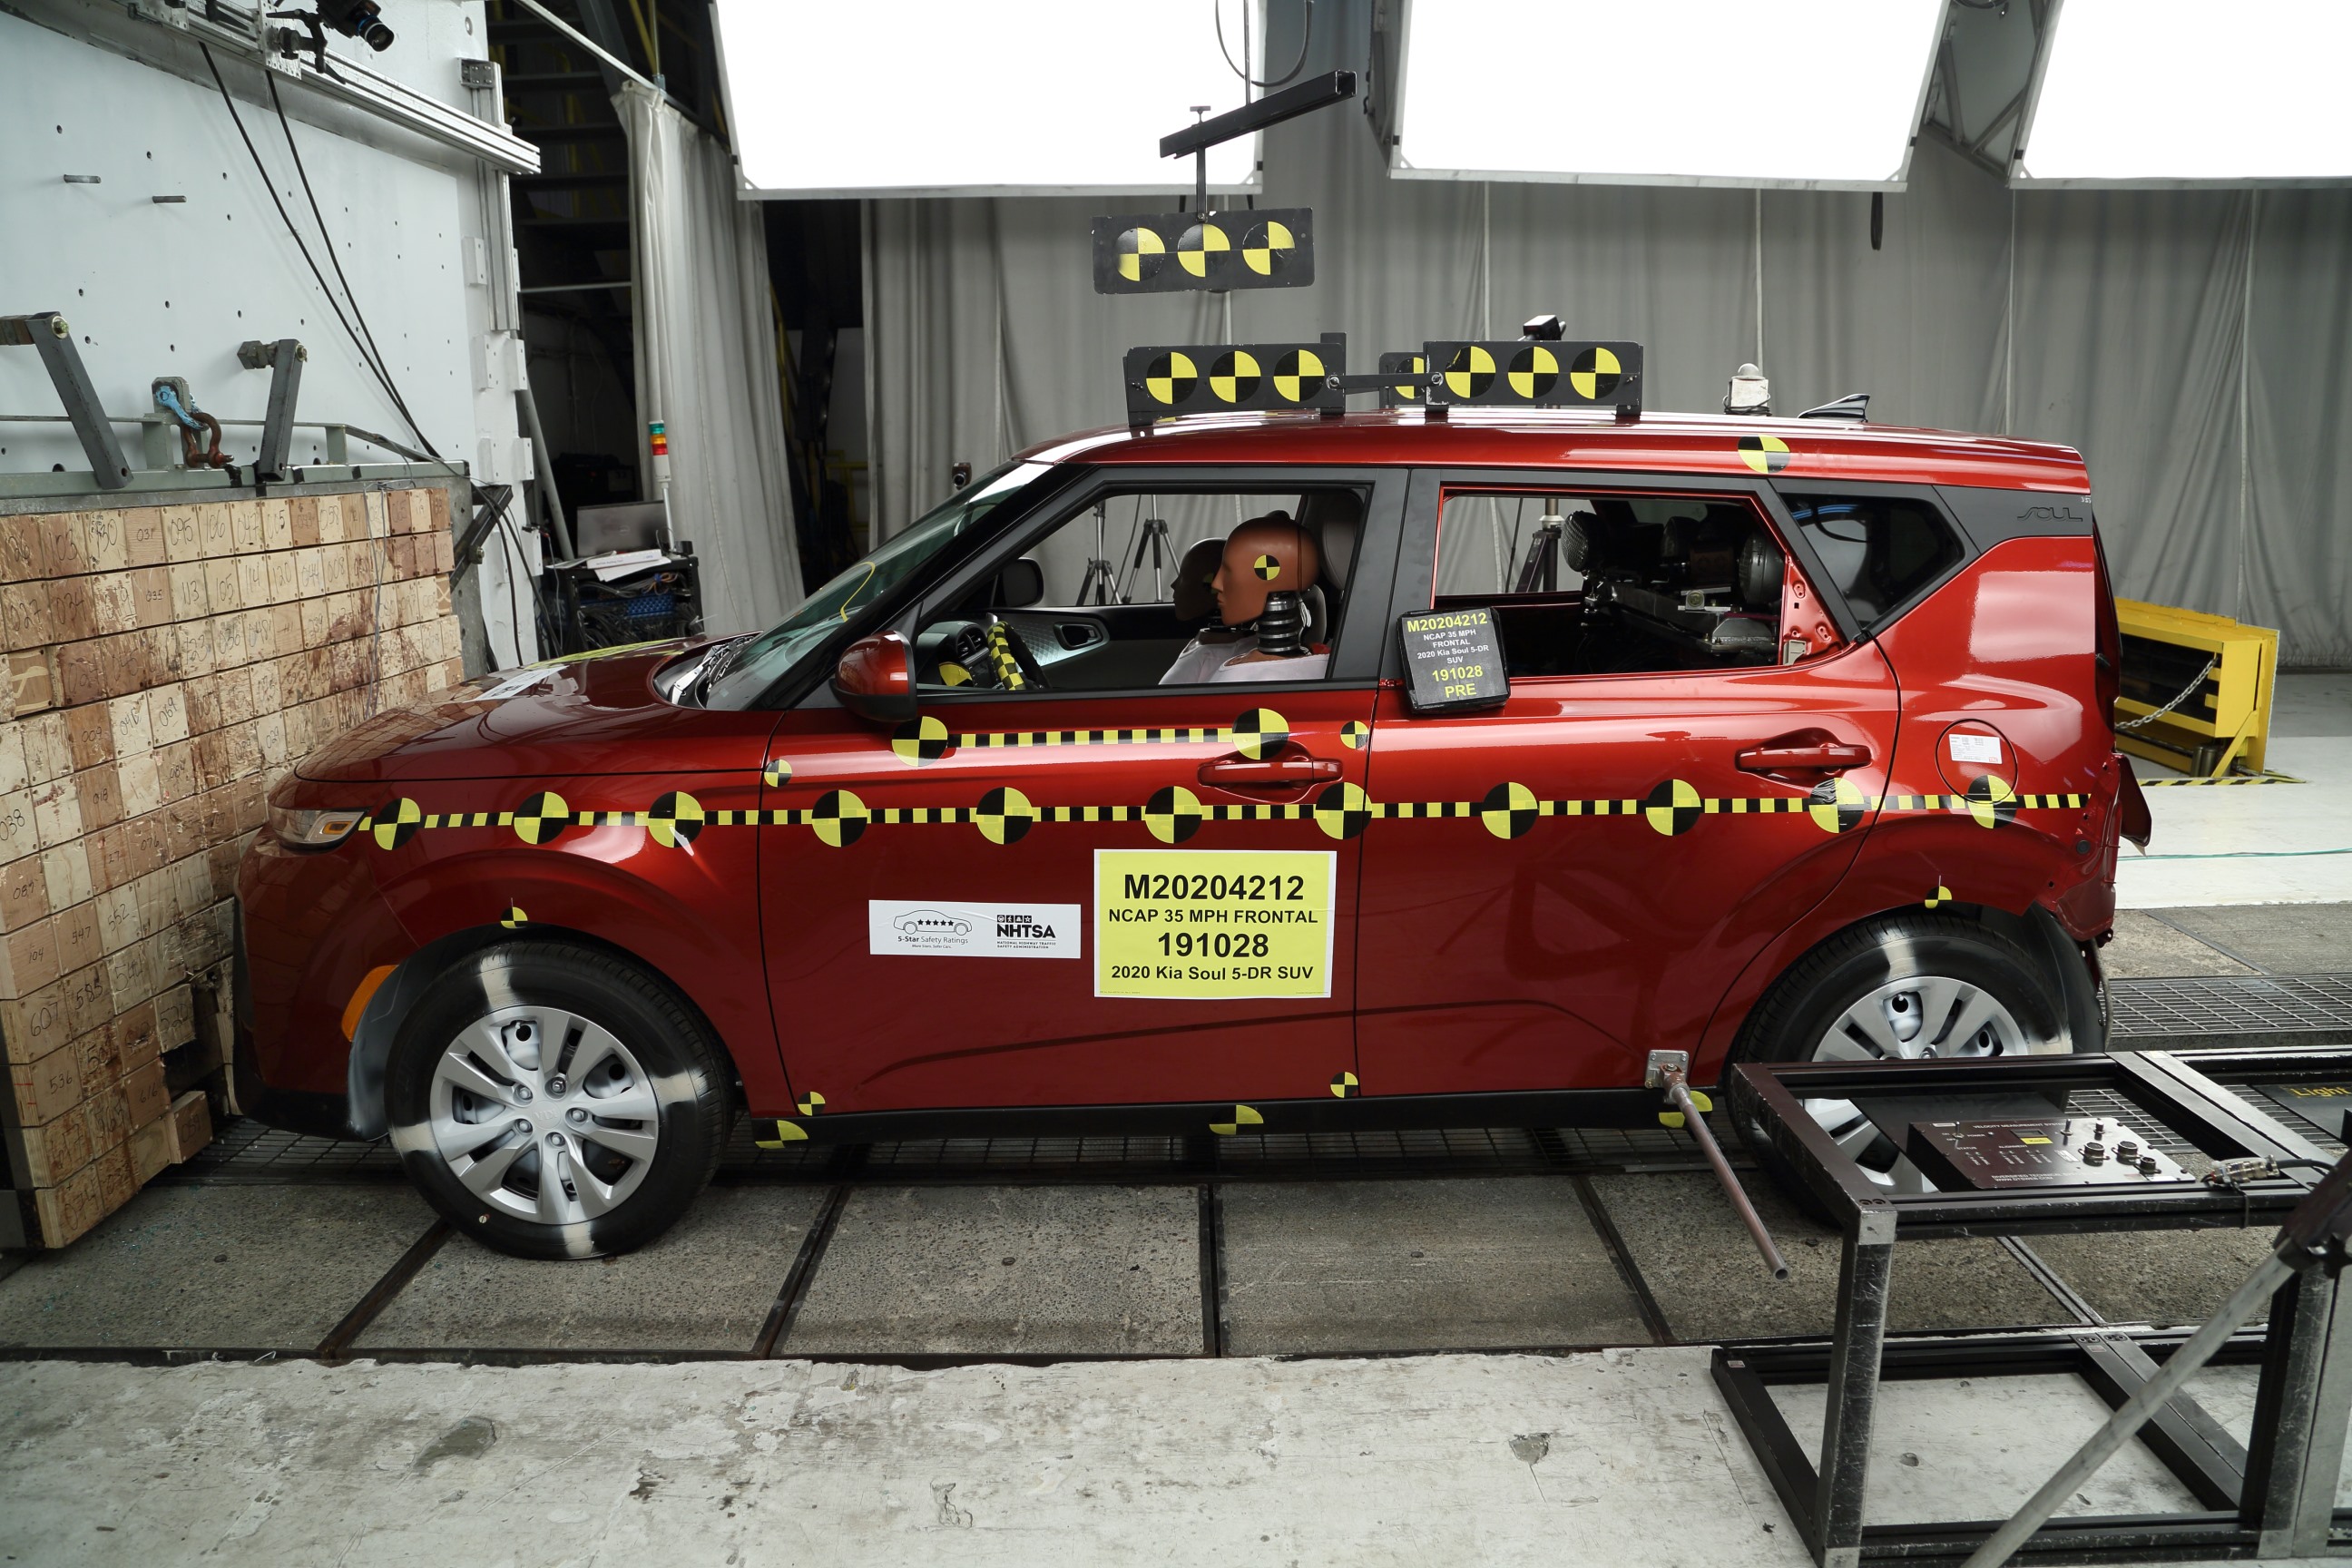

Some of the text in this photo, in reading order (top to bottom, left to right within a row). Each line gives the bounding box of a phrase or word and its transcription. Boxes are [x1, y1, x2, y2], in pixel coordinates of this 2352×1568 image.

[170, 517, 193, 545] 095
[181, 580, 200, 605] 113
[1407, 612, 1488, 632] M20204212
[1424, 632, 1446, 641] NCAP
[1458, 629, 1476, 637] MPH
[1433, 638, 1470, 648] FRONTAL
[1417, 651, 1436, 659] 2020
[1471, 644, 1489, 652] 5-DR
[1446, 656, 1464, 664] SUV
[1432, 665, 1483, 681] 191028
[1445, 683, 1476, 698] PRE
[159, 696, 177, 727] 069
[81, 726, 103, 743] 009
[0, 808, 25, 841] 038
[1124, 874, 1304, 900] M20204212
[107, 903, 130, 932] 552
[1109, 908, 1318, 924] NCAP 35 MPH FRONTAL
[72, 926, 91, 945] 547
[997, 924, 1056, 938] NHTSA
[944, 936, 968, 946] Ratings
[1158, 932, 1269, 958] 191028
[28, 946, 44, 964] 104
[1111, 965, 1314, 981] 2020 Kia Soul 5-DR SUV
[31, 1002, 59, 1037] 607
[49, 1073, 73, 1095] 536
[140, 1082, 158, 1103] 616
[2290, 1086, 2351, 1097] Light
